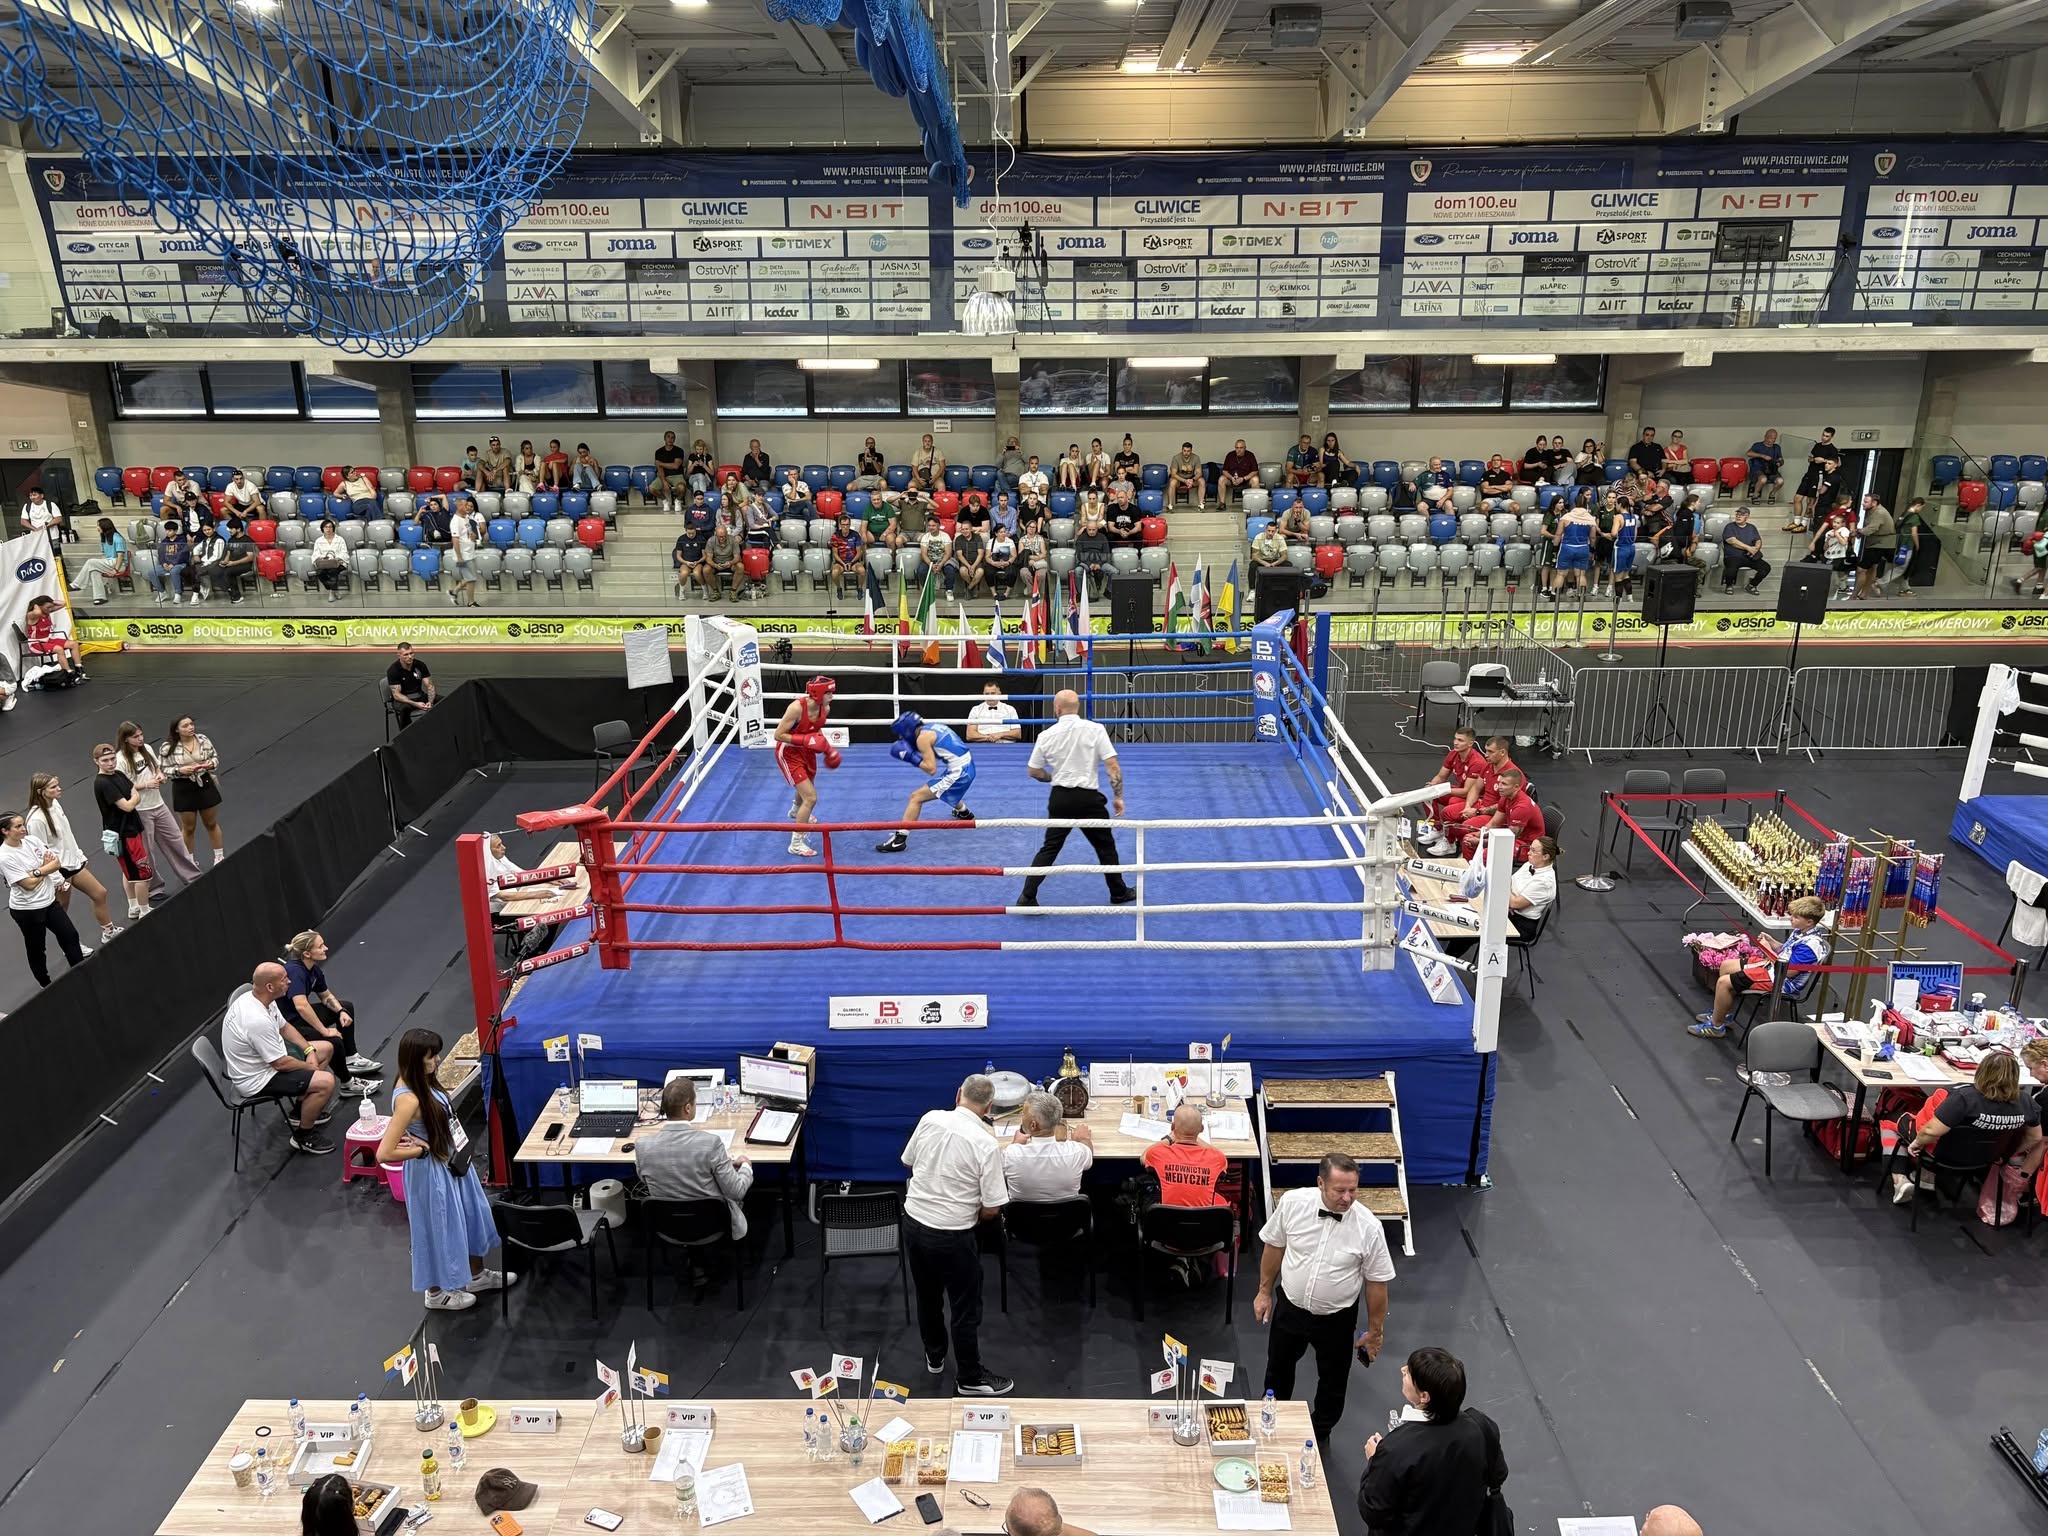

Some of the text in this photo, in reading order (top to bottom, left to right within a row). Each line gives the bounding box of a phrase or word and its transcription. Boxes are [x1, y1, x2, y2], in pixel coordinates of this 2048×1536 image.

[1742, 155, 1849, 166] WWW.PIASTGLIWICE.COM
[1279, 163, 1385, 174] WWW.PIASTGLIWICE.COM
[1434, 196, 1517, 210] dom100.eu
[1590, 192, 1659, 208] GLIWICE
[528, 203, 610, 216] dom100.eu
[681, 202, 748, 216] GLIWICE
[1134, 200, 1201, 214] GLIWICE
[1433, 211, 1453, 219] NOWE
[1476, 210, 1516, 218] MIESZKANIA
[1595, 209, 1653, 218] Przyszłość jest tu.
[689, 218, 721, 226] Przyszłość
[722, 218, 733, 226] jest
[1140, 216, 1173, 224] Przyszłość
[1174, 216, 1186, 224] jest
[1693, 230, 1717, 240] TOM
[786, 238, 832, 249] TOMEX
[1238, 236, 1283, 247] TOMEX
[1594, 257, 1638, 269] OstroVit
[1787, 253, 1815, 261] ASNA
[880, 263, 910, 271] JASNA
[1143, 263, 1186, 274] OstroVit
[1330, 259, 1360, 268] JASNA
[695, 265, 738, 276] OstroVit
[1475, 282, 1494, 291] NEXT
[1929, 277, 1949, 285] NEXT
[580, 289, 600, 297] NEXT
[1210, 304, 1246, 316] kafar
[1657, 299, 1694, 311] kafar
[764, 306, 799, 318] kafar
[76, 626, 119, 638] FUTSAL
[193, 626, 273, 637] BOULDERING
[347, 624, 499, 638] ŚCIANKA WSPINACZKOWA
[574, 624, 624, 637] SQUASH
[1256, 641, 1273, 655] B
[504, 873, 518, 885] B
[558, 865, 571, 876] B
[1426, 864, 1458, 878] BAIL
[523, 917, 537, 928] B
[574, 905, 588, 916] B
[1408, 903, 1420, 913] B
[1456, 915, 1470, 927] B
[521, 961, 534, 972] B
[571, 946, 584, 957] B
[1487, 952, 1500, 965] A
[879, 1001, 899, 1017] B
[873, 1017, 904, 1025] BAIL
[1978, 1112, 2025, 1125] RATOWNIK
[1164, 1164, 1211, 1176] RATOWNICTWO
[1165, 1172, 1210, 1187] MEDYCZNE
[979, 1413, 994, 1421] VIP
[319, 1431, 335, 1439] VIP
